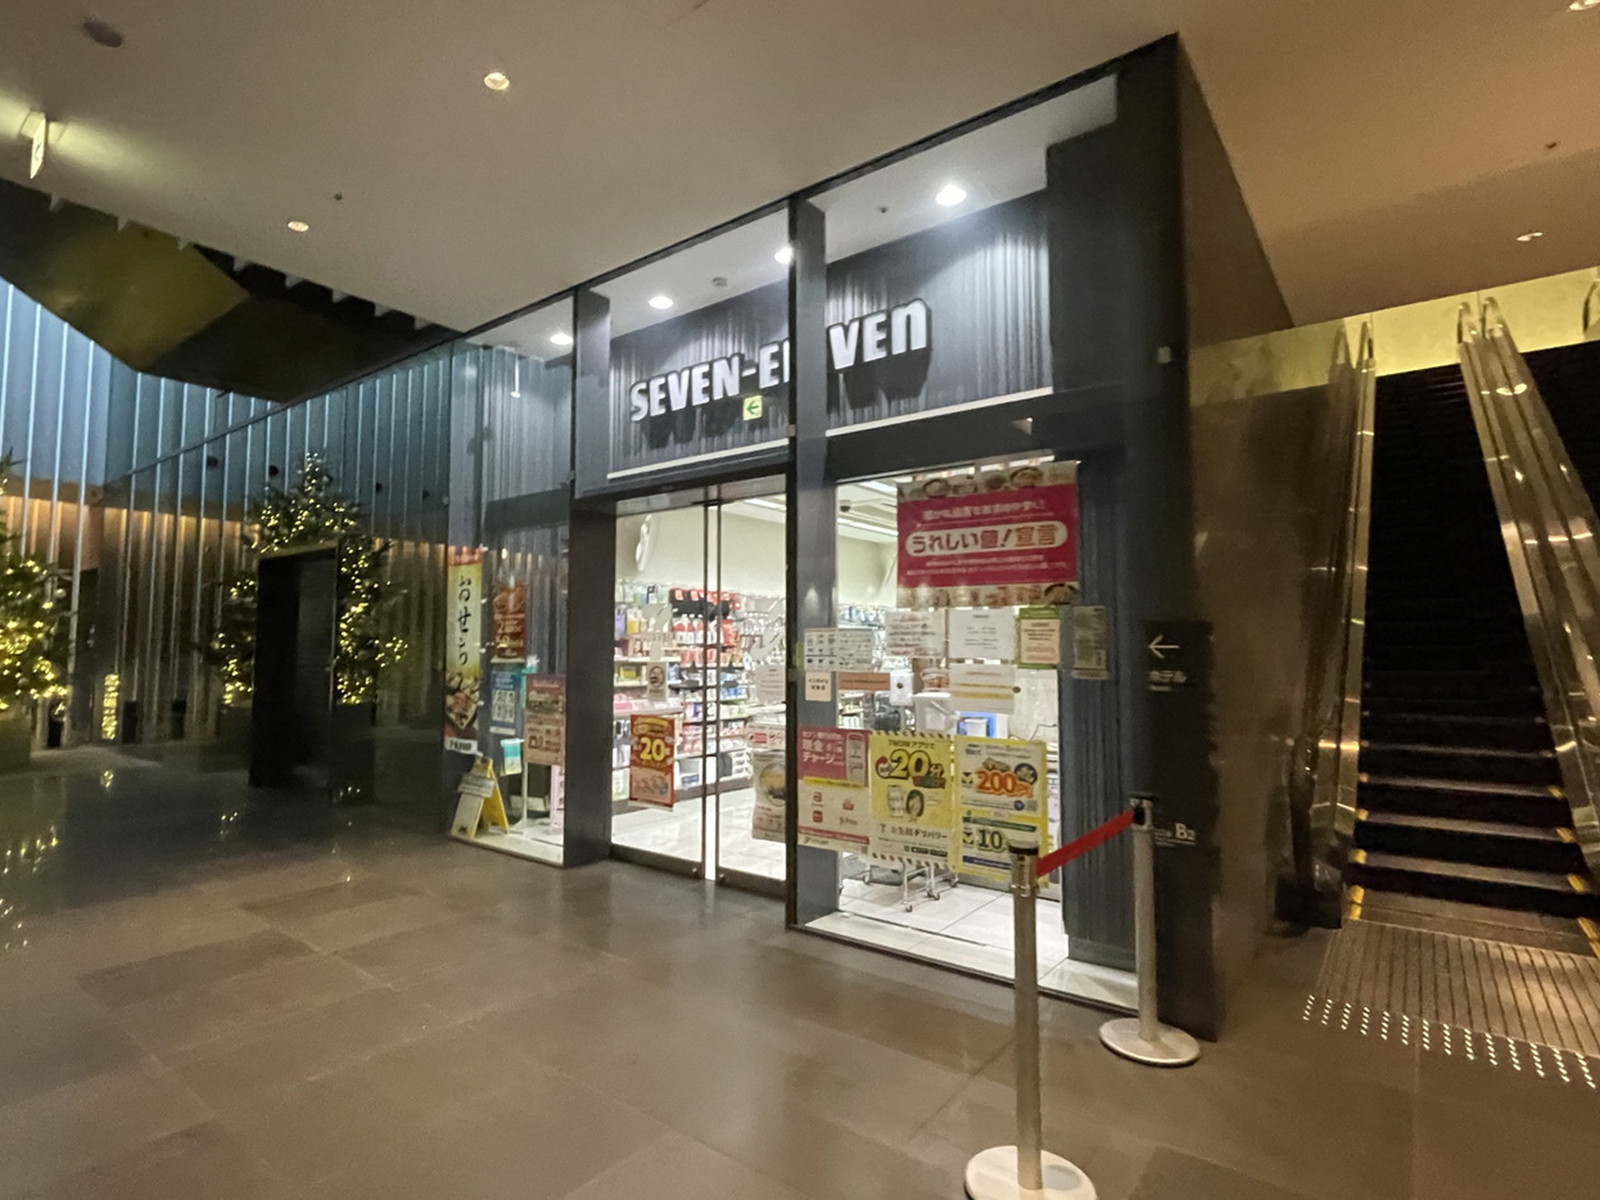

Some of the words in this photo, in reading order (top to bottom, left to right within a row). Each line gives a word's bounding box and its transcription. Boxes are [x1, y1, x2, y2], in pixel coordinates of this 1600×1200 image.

[630, 299, 928, 422] SEVEN-EVEn
[640, 737, 665, 761] 20
[977, 770, 1015, 793] 200
[978, 829, 1003, 850] 10
